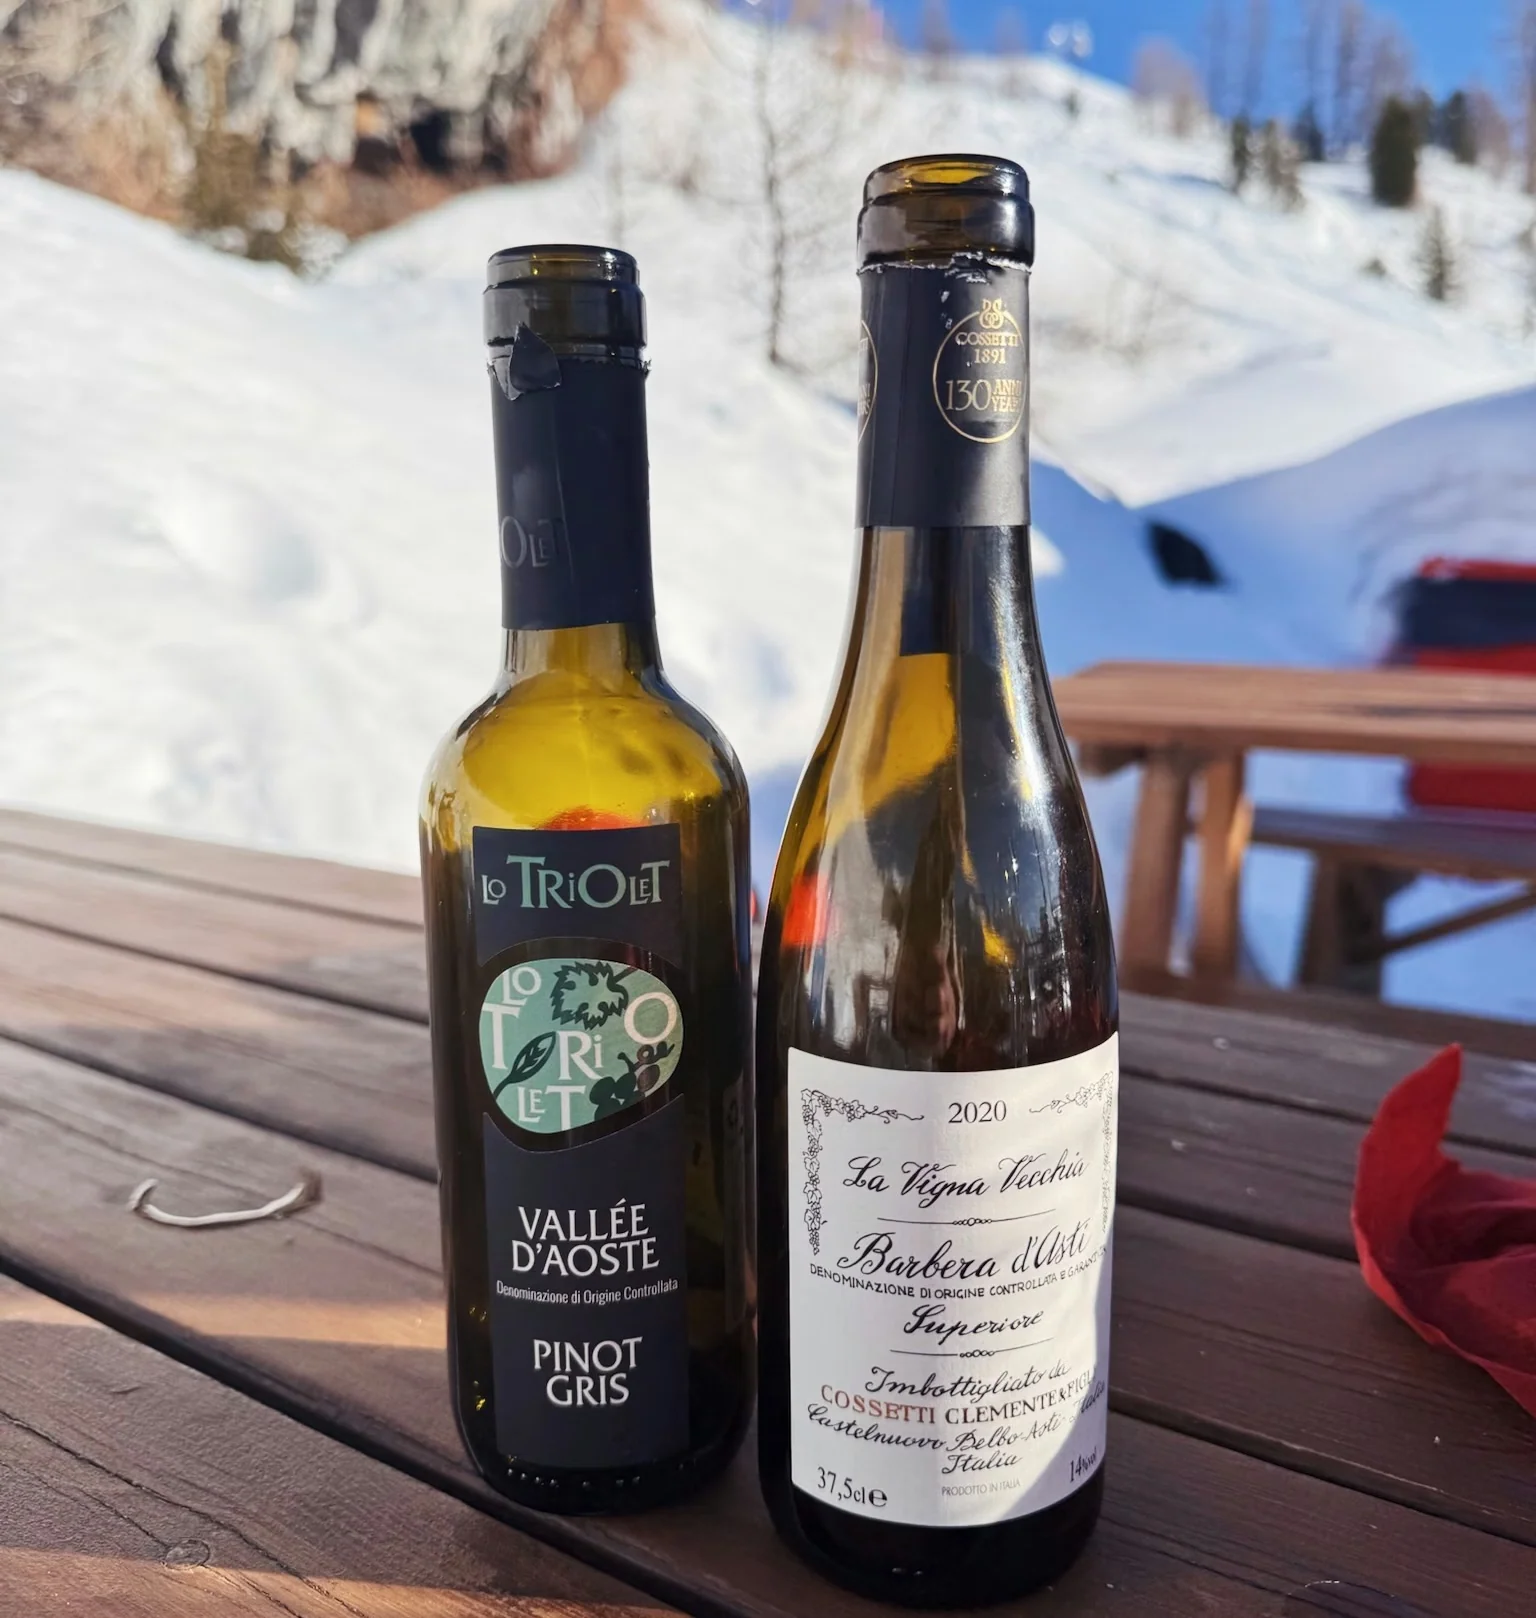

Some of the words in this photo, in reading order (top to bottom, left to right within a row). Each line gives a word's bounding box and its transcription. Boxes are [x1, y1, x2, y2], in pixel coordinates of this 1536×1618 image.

[955, 332, 1018, 346] COSSETTI
[974, 348, 1006, 364] 1891
[945, 379, 992, 411] 130
[481, 874, 507, 905] LO
[948, 1100, 1007, 1124] 2020
[842, 1155, 890, 1193] La
[901, 1160, 992, 1208] Vigna
[998, 1149, 1091, 1194] Vecchia
[518, 1197, 649, 1241] VALLÉE
[836, 1231, 1000, 1280] Barbera
[1011, 1218, 1091, 1274] d'Asti
[496, 1280, 569, 1305] Denominazione
[571, 1289, 581, 1304] di
[583, 1289, 622, 1306] Origine
[623, 1277, 679, 1301] Controllata
[810, 1262, 915, 1298] DENOMINAZIONE
[920, 1287, 932, 1299] DI
[934, 1287, 985, 1300] ORIGINE
[989, 1271, 1058, 1297] CONTROLLATA
[1059, 1269, 1066, 1280] E
[903, 1303, 1044, 1346] Superiore
[533, 1336, 643, 1373] PINOT
[546, 1373, 630, 1406] GRIS
[865, 1364, 1047, 1404] Imbottigliato
[1048, 1358, 1072, 1380] da
[821, 1384, 936, 1425] COSSETTI
[807, 1402, 946, 1450] Castelnuovo
[941, 1449, 1023, 1475] Italia
[941, 1483, 988, 1497] PRODOTTO
[989, 1481, 998, 1492] IN
[999, 1477, 1021, 1490] ITALIA
